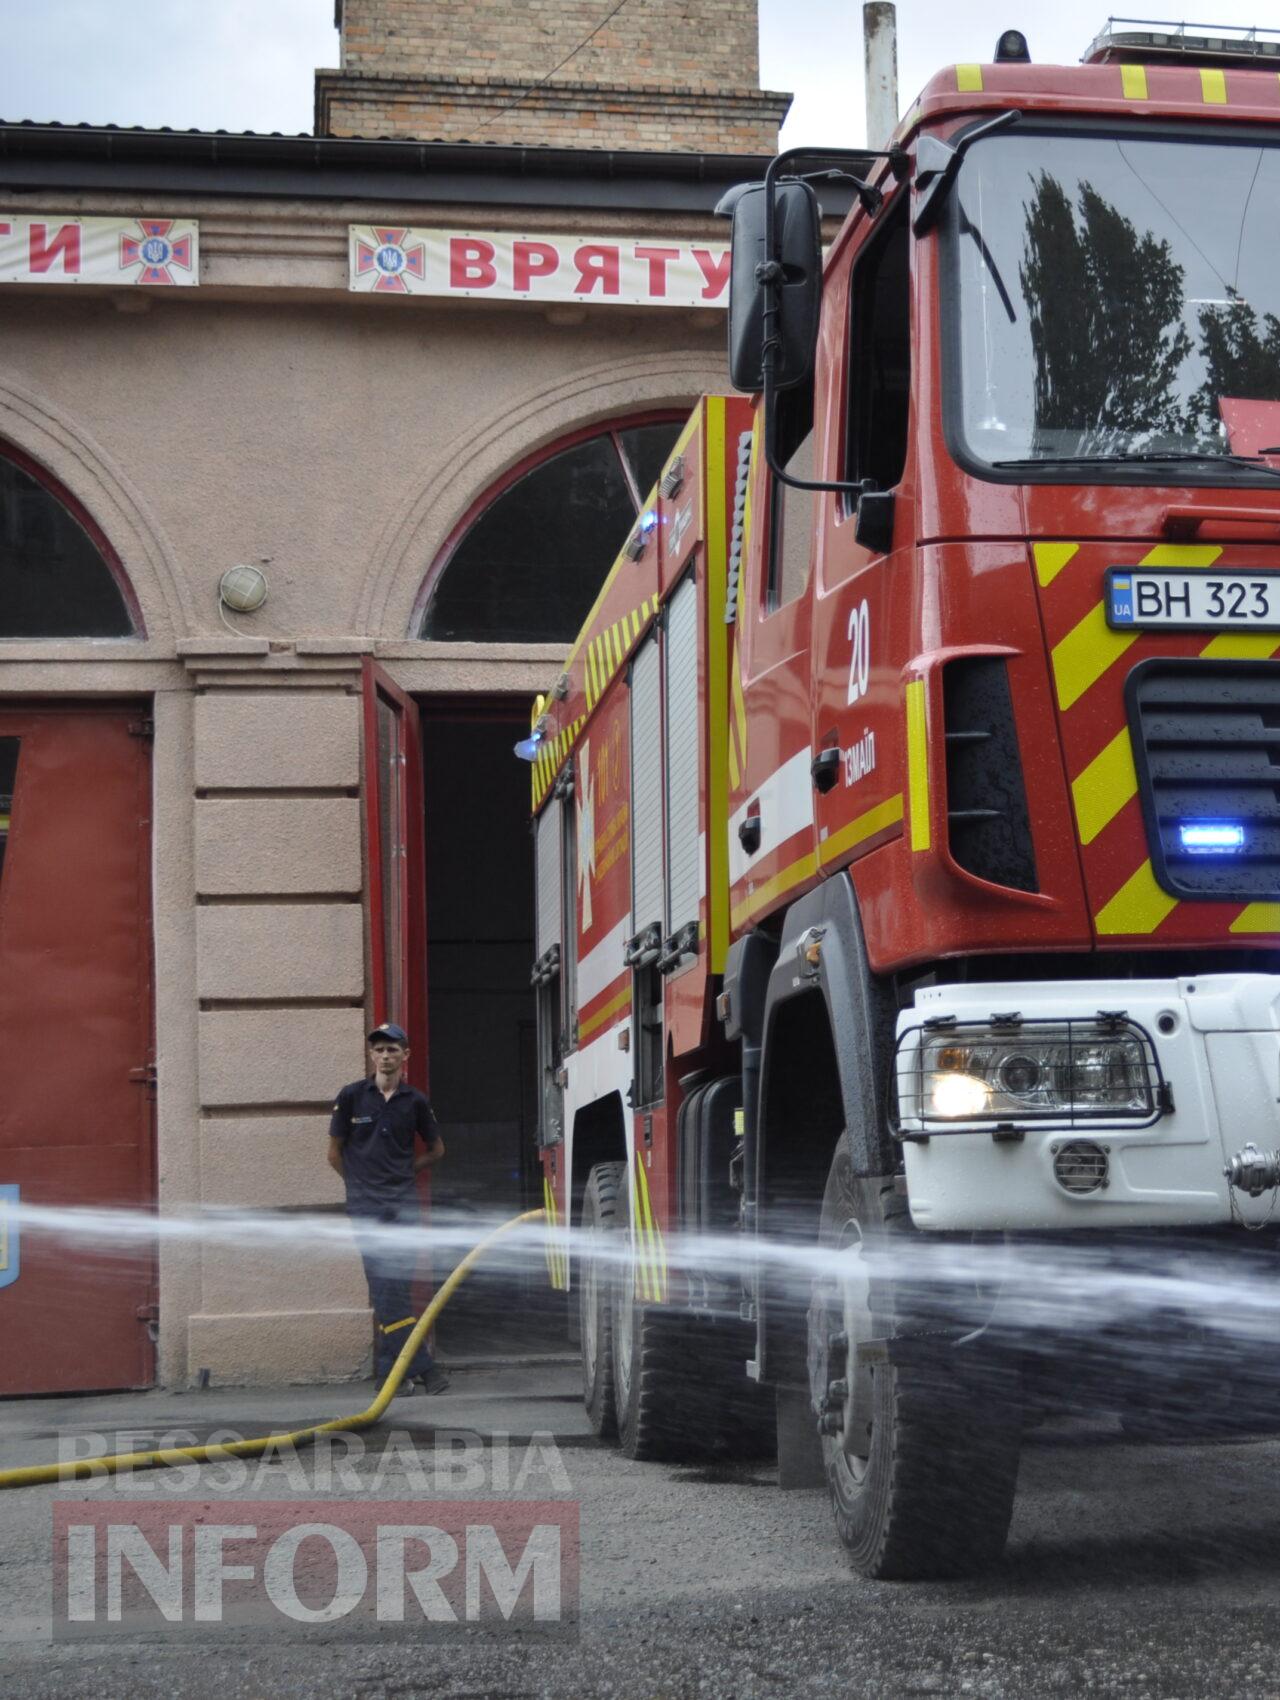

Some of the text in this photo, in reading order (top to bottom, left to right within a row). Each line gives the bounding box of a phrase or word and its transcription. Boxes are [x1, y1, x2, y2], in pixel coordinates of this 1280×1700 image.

[0, 223, 80, 273] И
[1114, 604, 1131, 616] UA
[1206, 582, 1269, 618] 323
[847, 598, 870, 706] 20
